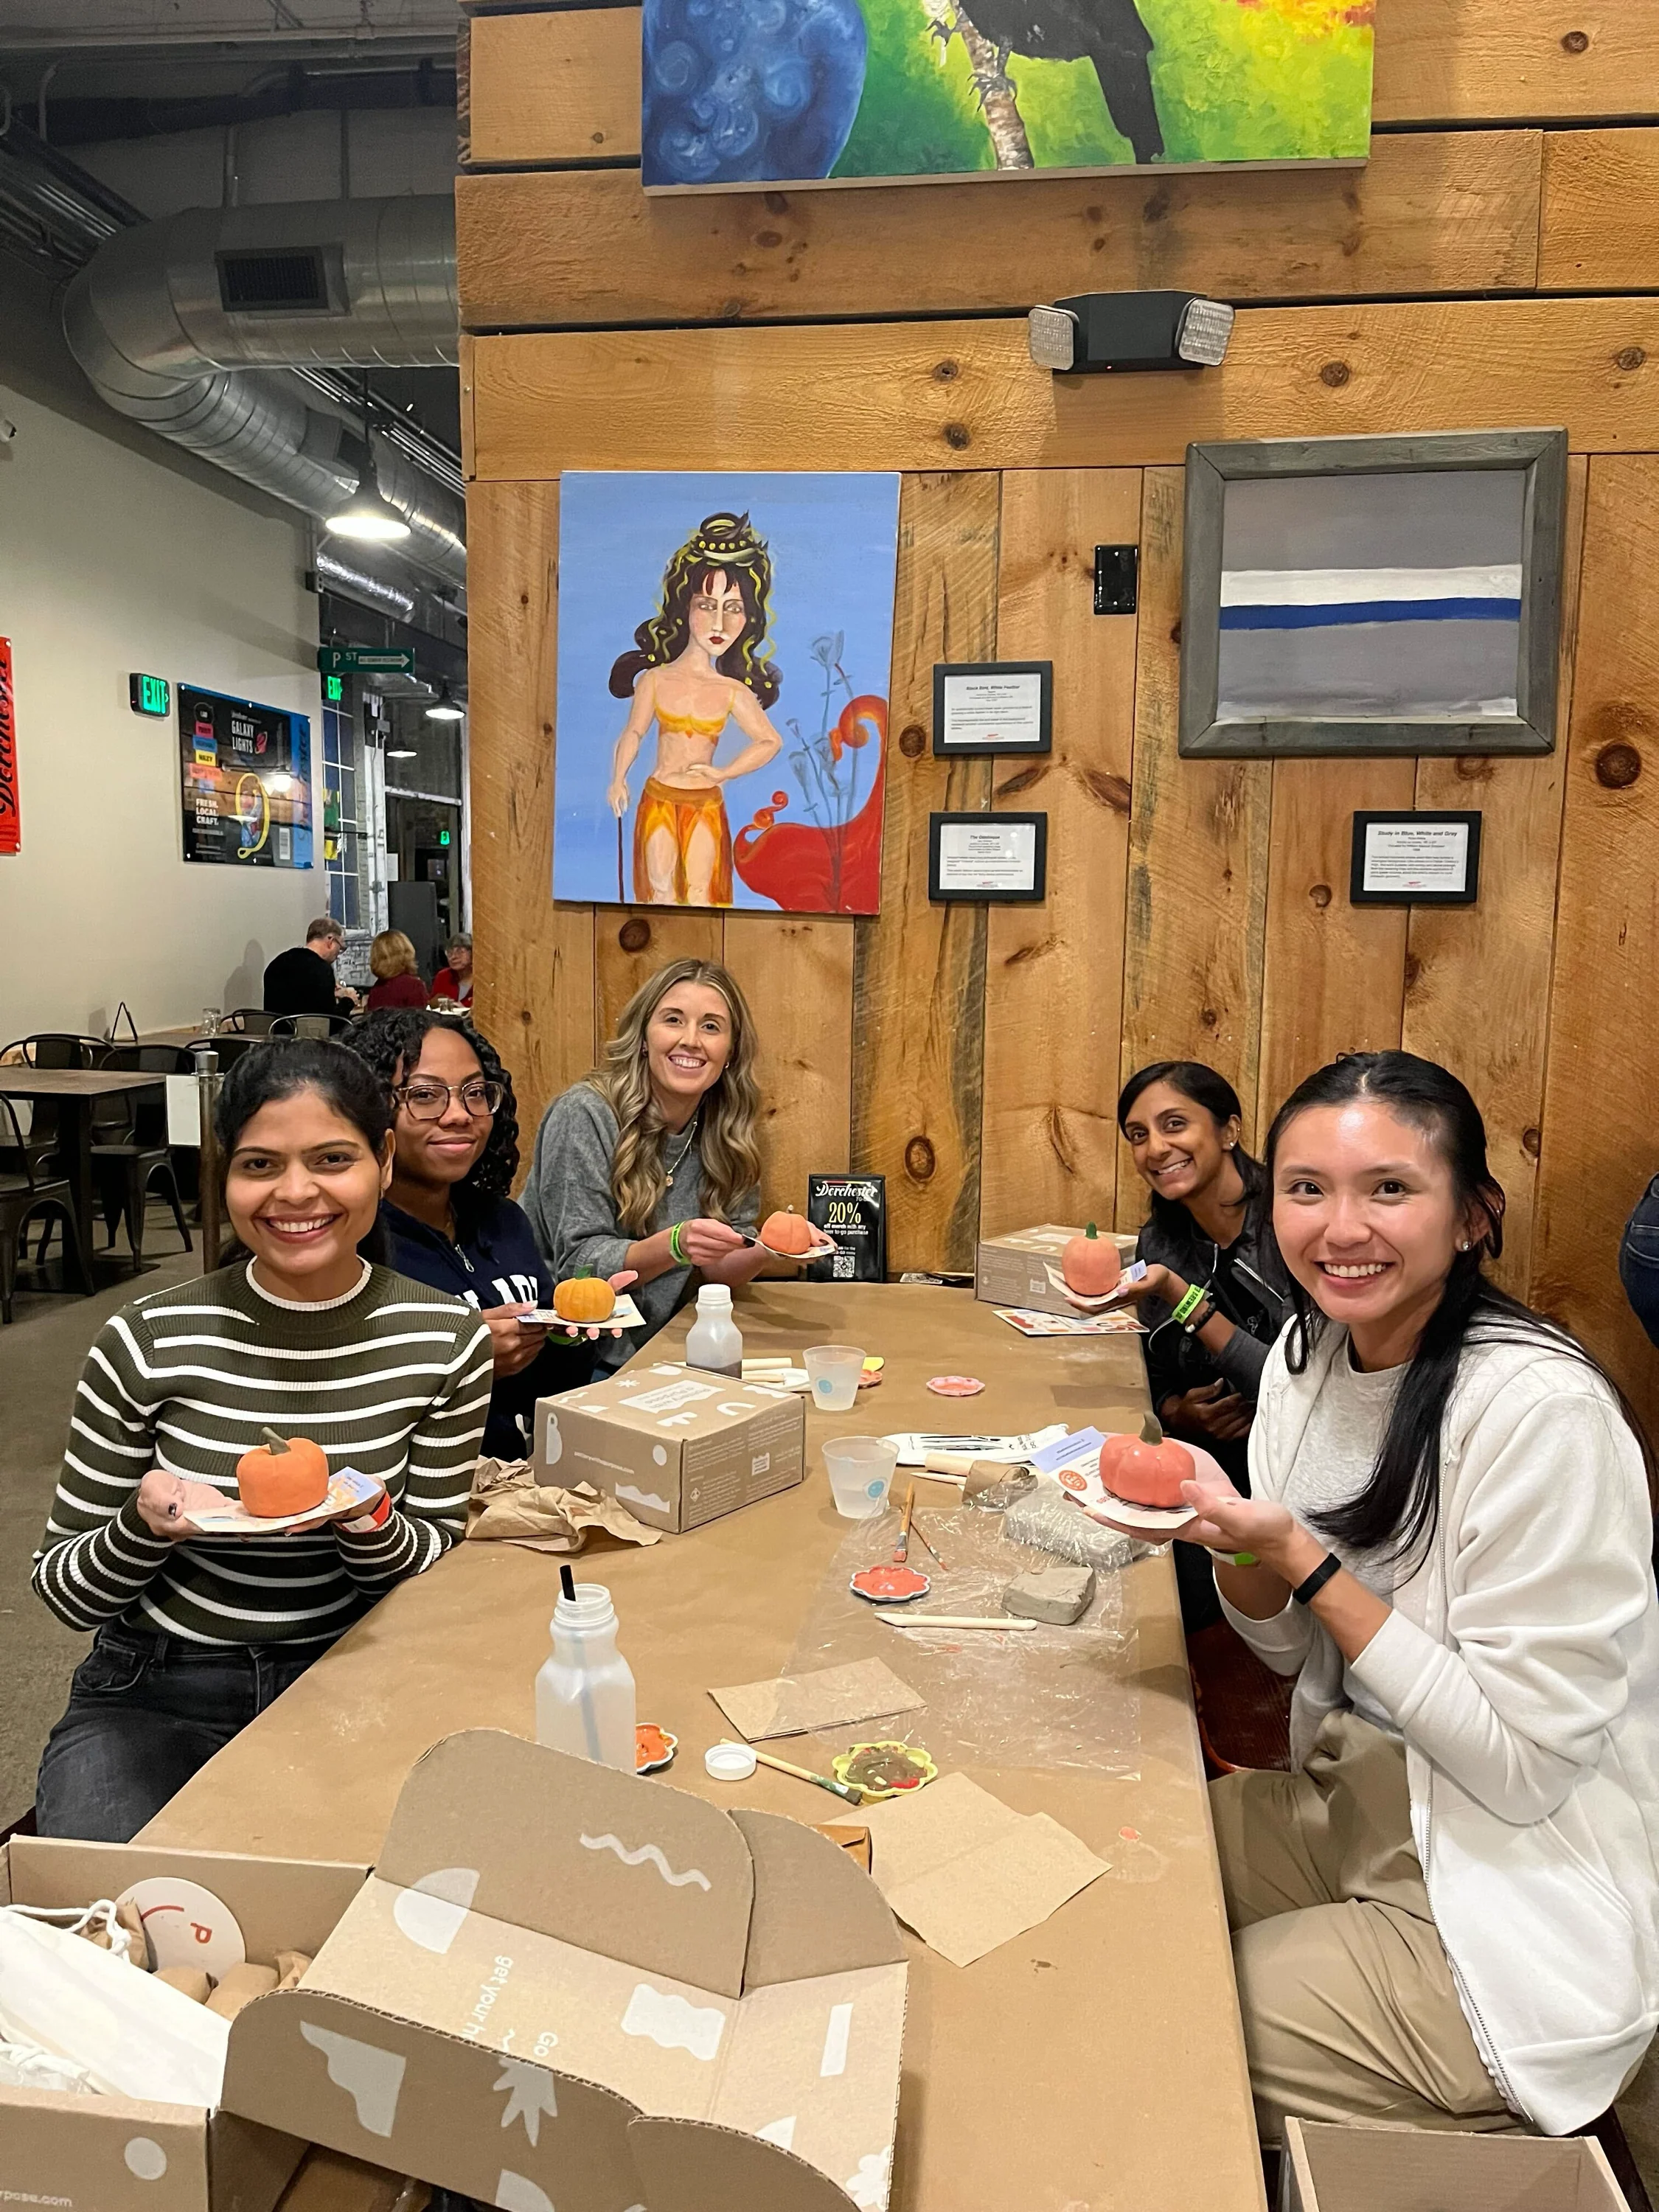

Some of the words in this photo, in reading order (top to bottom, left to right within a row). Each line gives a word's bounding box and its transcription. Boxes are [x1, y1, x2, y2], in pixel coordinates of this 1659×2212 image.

[333, 652, 341, 668] P
[345, 652, 358, 661] ST
[142, 675, 166, 714] EXIT
[327, 675, 341, 701] EXIT
[231, 720, 254, 739] GALAXY
[232, 736, 254, 754] LIGHTS
[195, 798, 219, 809] FRESH.
[195, 807, 219, 816] LOCAL.
[196, 815, 220, 826] CRAFT.
[815, 1180, 878, 1197] Dorchester
[828, 1201, 862, 1224] 20%
[490, 1955, 514, 1984] get
[471, 1984, 501, 2022] your
[534, 2031, 558, 2057] Go
